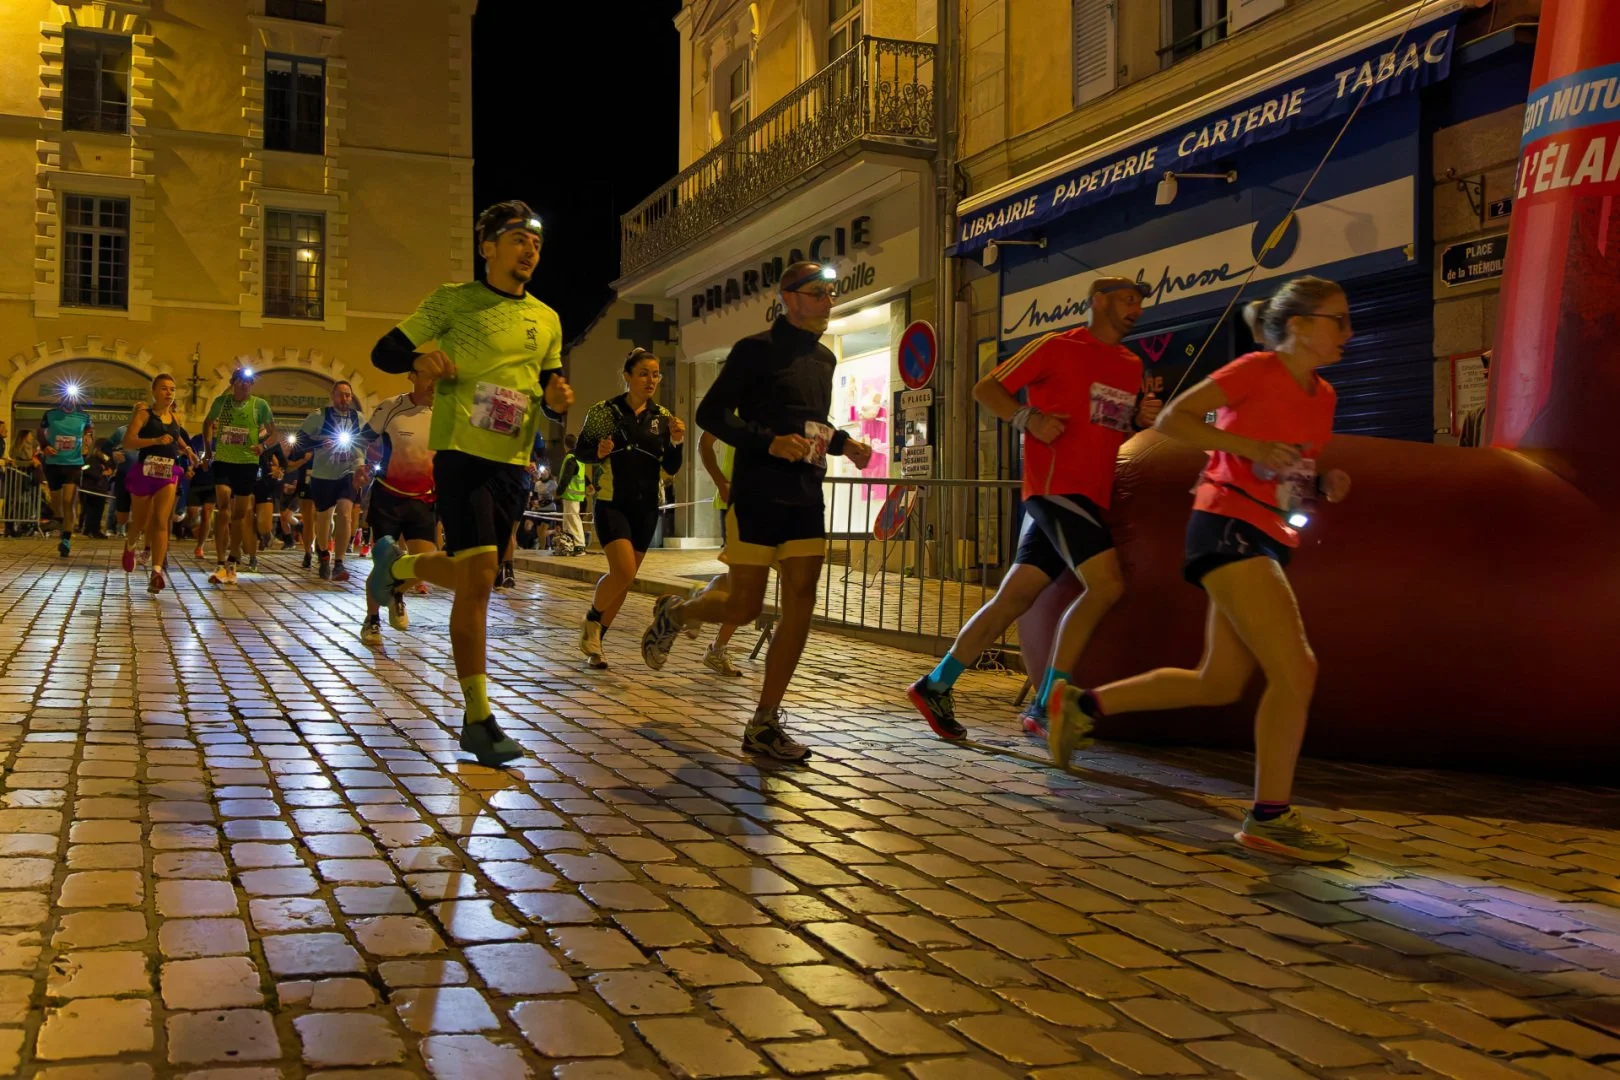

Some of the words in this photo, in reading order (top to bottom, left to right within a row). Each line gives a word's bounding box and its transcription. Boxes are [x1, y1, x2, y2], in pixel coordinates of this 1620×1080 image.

[961, 195, 1039, 241] LIBRAIRIE
[1052, 147, 1158, 206] PAPETERIE
[1178, 88, 1306, 157] CARTERIE
[1335, 29, 1449, 98] TABAC
[1497, 202, 1504, 214] 2
[1466, 243, 1493, 258] PLACE
[692, 215, 871, 318] PHARMACIE
[1447, 269, 1457, 280] de
[1458, 267, 1466, 278] la
[907, 393, 931, 405] PLACES
